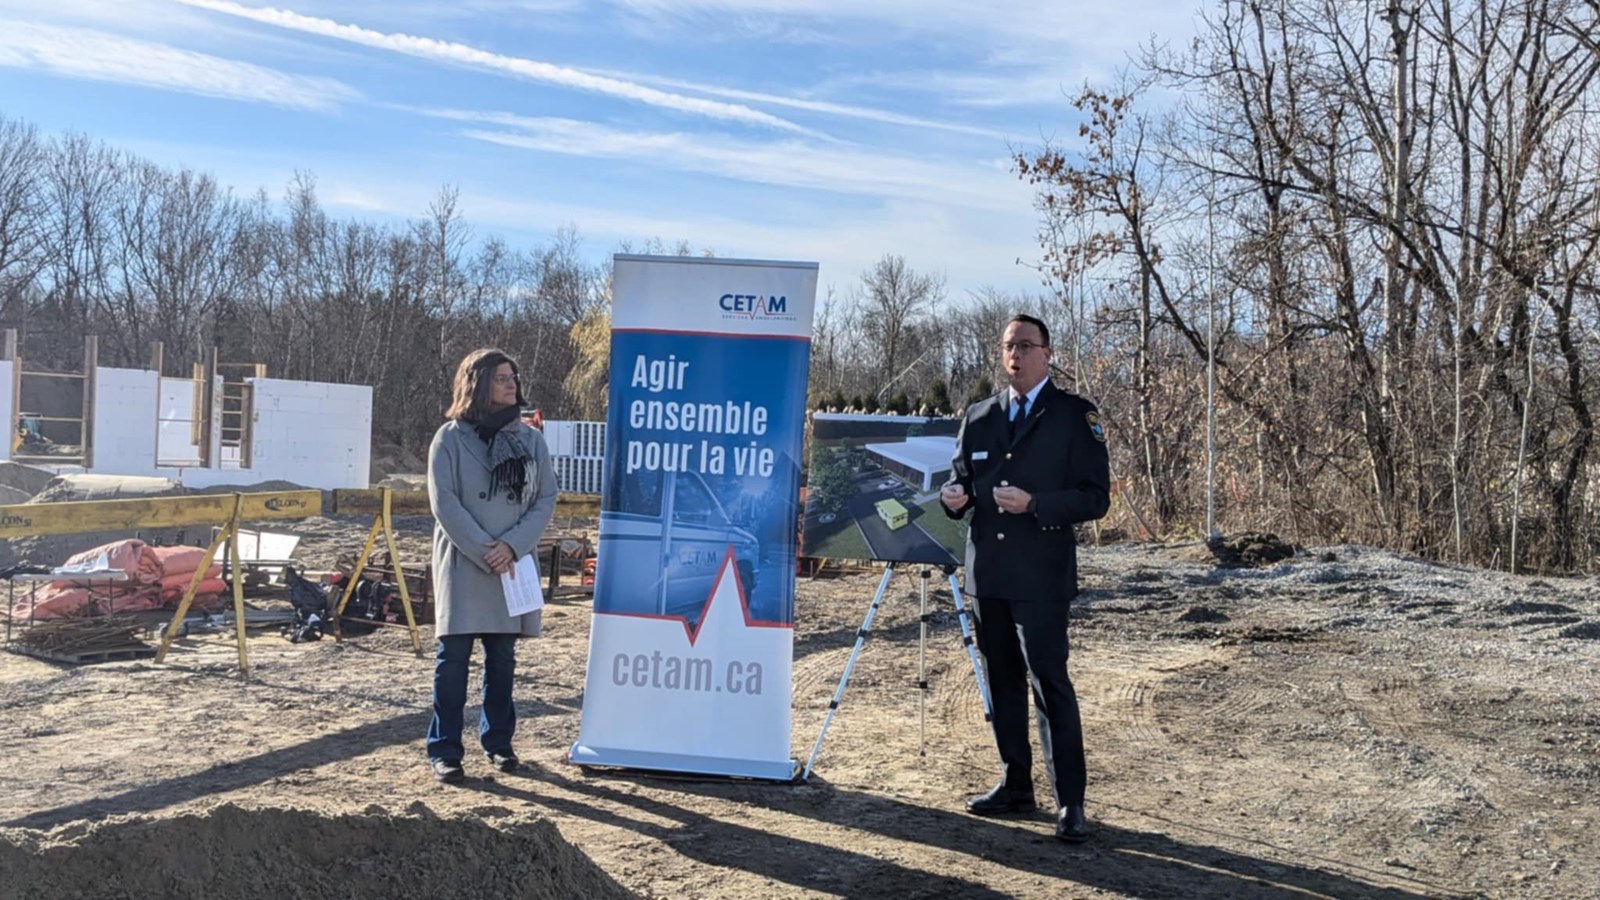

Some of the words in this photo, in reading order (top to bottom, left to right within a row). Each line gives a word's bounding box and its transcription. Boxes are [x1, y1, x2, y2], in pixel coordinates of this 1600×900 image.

[719, 294, 787, 315] CETAM
[631, 354, 689, 393] Agir
[629, 399, 768, 436] ensemble
[626, 440, 693, 475] pour
[700, 440, 725, 475] la
[733, 441, 774, 477] vie
[678, 550, 717, 565] CETAM
[612, 650, 763, 696] cetam.ca
